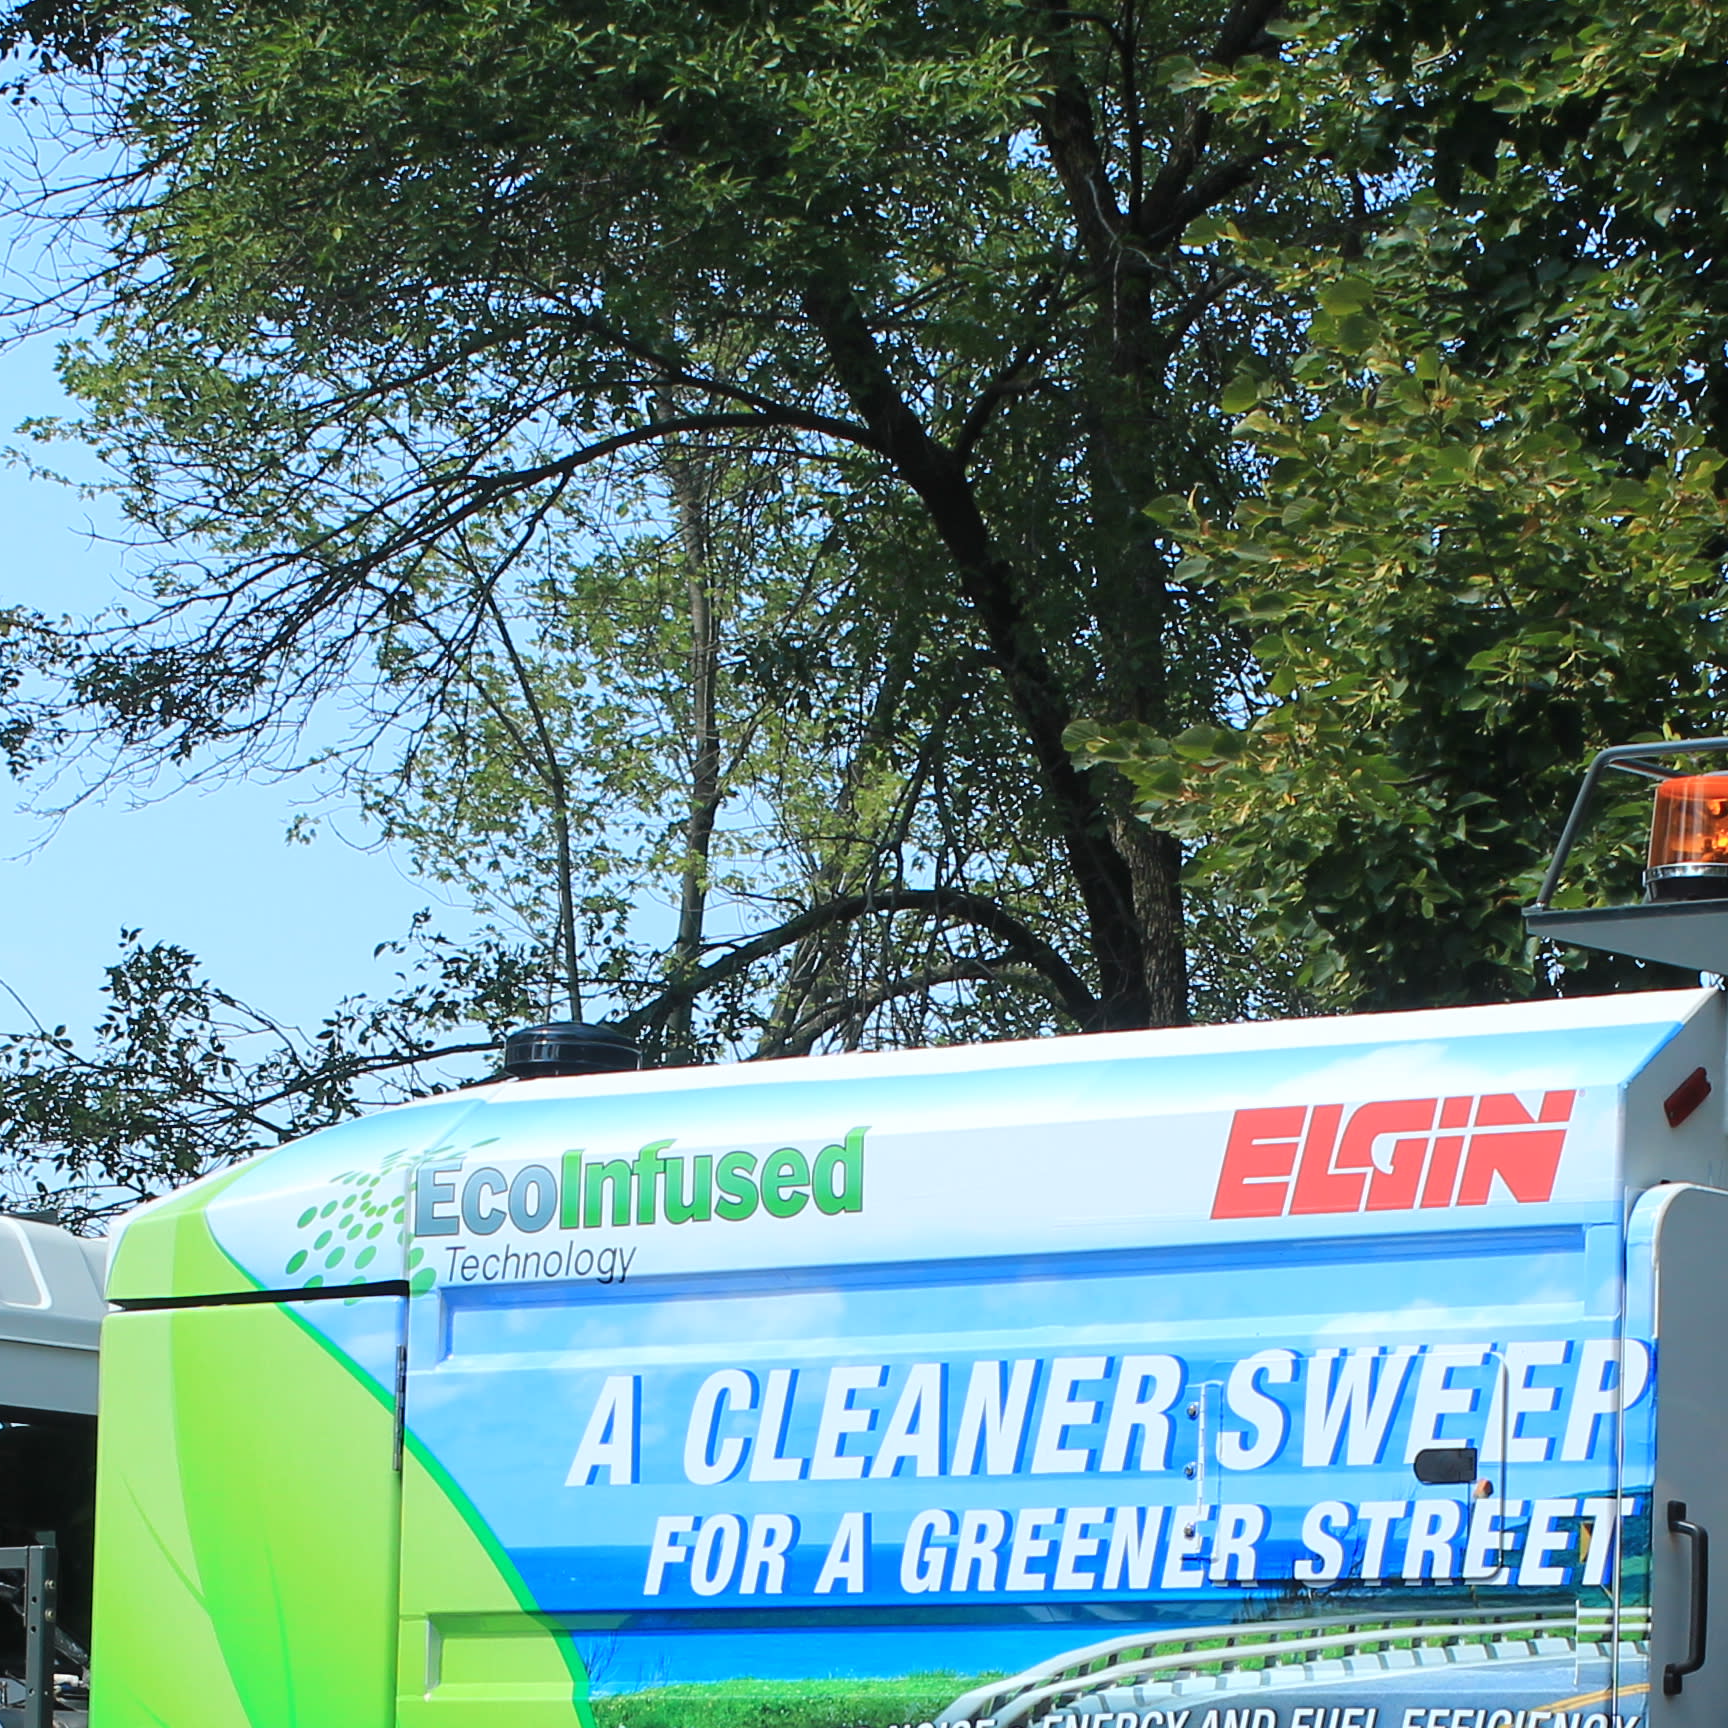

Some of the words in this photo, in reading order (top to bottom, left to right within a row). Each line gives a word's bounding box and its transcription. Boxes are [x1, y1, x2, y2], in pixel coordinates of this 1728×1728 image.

[415, 1126, 871, 1236] EcoInfused
[1210, 1089, 1577, 1220] ELGIN
[446, 1240, 637, 1284] Technology
[565, 1375, 642, 1487] A
[684, 1353, 1191, 1486] CLEANER
[1215, 1338, 1656, 1471] SWEEP
[643, 1513, 801, 1596] FOR
[814, 1512, 872, 1594] A
[900, 1503, 1269, 1595] GREENER
[1294, 1497, 1640, 1588] STREET
